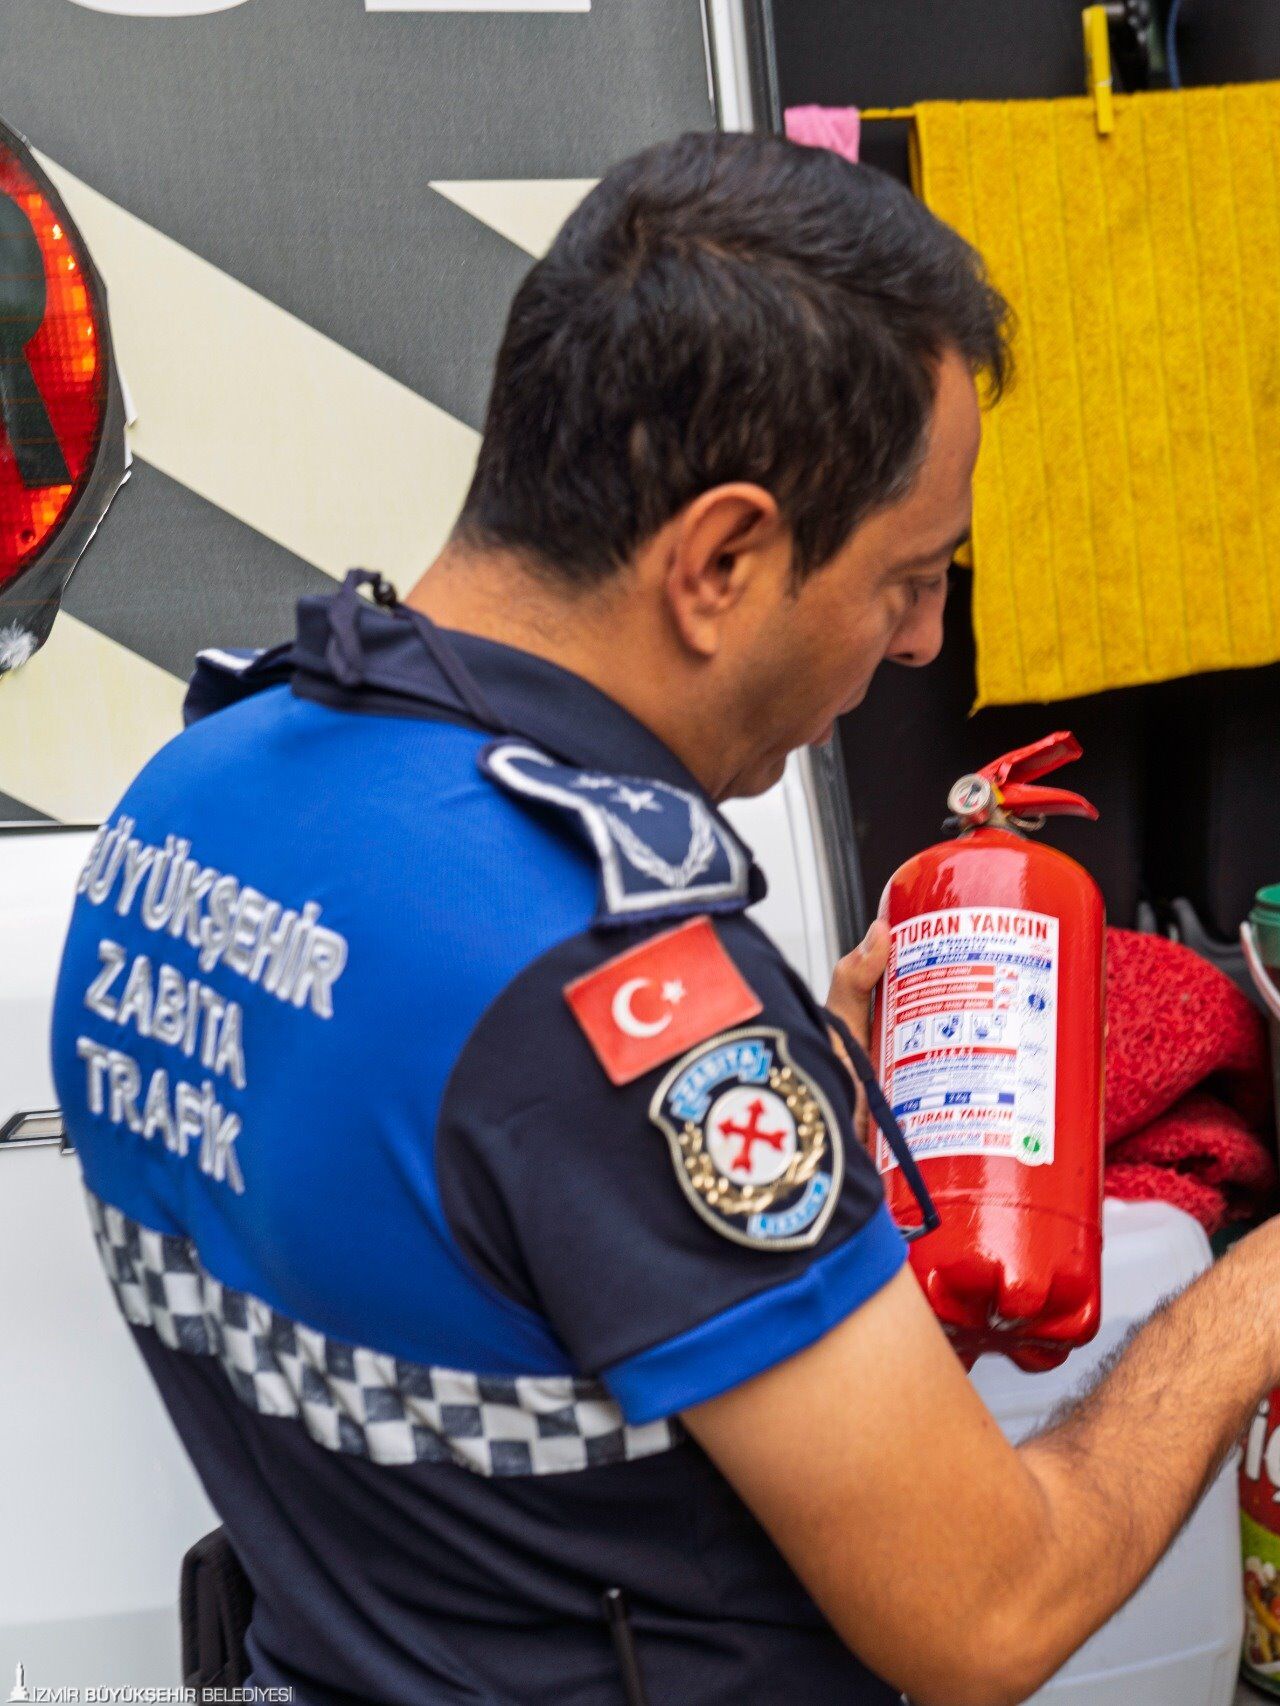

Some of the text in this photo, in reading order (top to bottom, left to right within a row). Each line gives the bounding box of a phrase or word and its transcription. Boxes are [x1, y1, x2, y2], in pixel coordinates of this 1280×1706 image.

[898, 915, 960, 948] TURAN
[970, 913, 1048, 939] YANGIN
[84, 938, 248, 1090] ZABITA
[76, 1036, 246, 1193] TRAFİK
